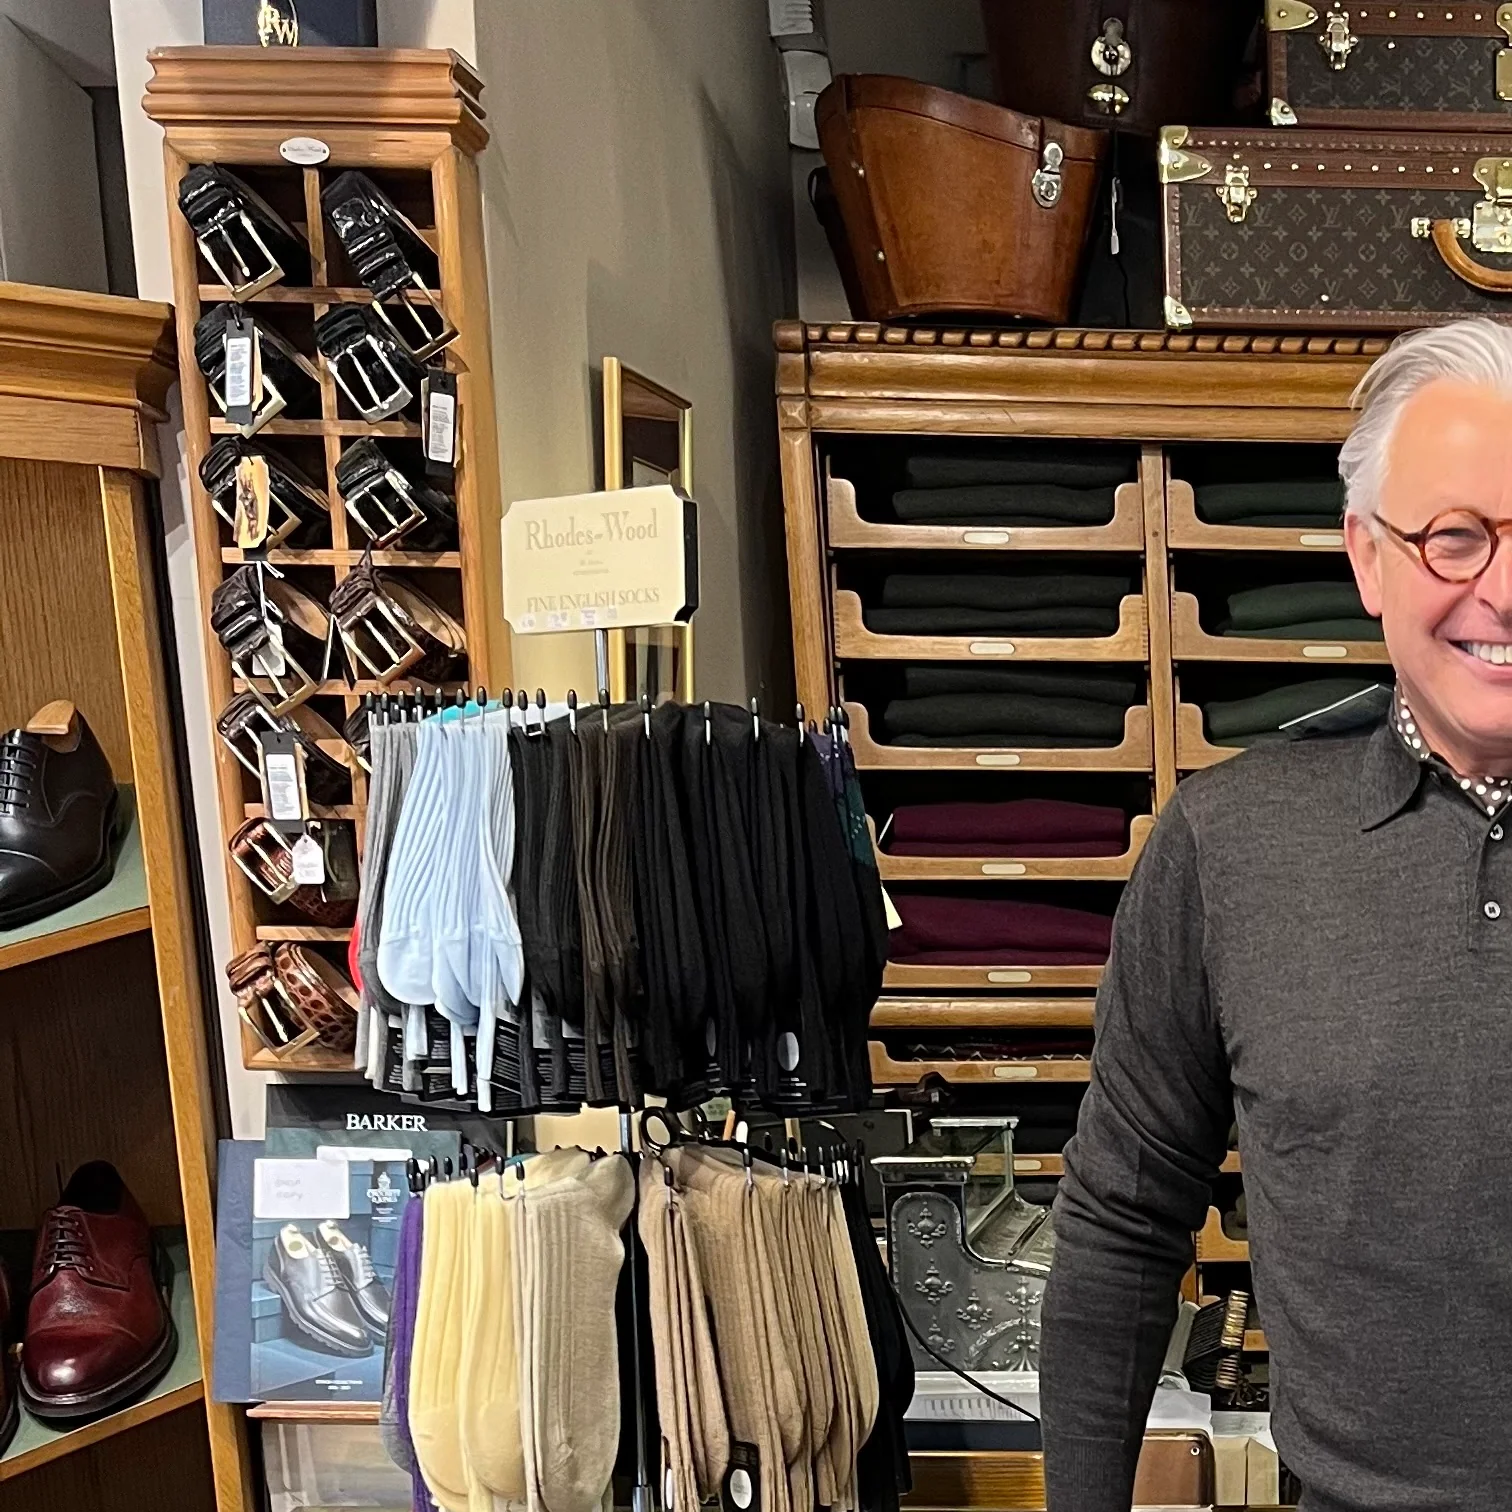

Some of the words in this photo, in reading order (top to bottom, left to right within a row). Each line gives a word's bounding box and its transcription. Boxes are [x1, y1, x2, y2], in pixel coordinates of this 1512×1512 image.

[524, 508, 660, 551] Rhodes-Wood
[527, 595, 557, 613] FINE
[559, 590, 616, 611] ENGLISH
[618, 588, 660, 605] SOCKS
[346, 1113, 429, 1132] BARKER
